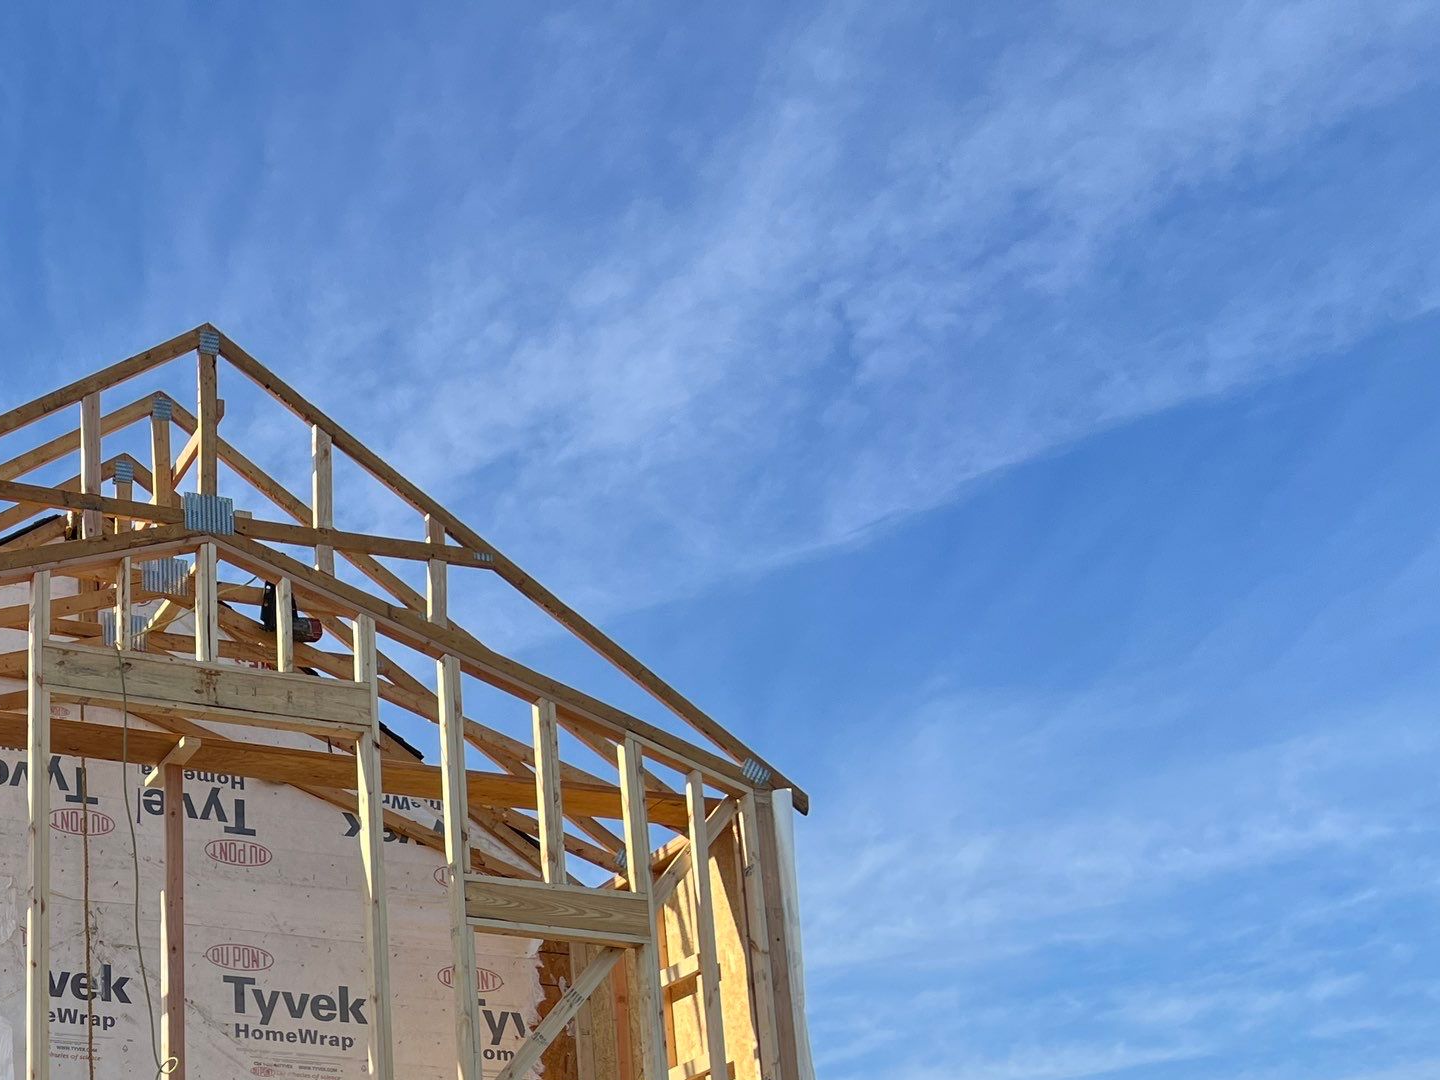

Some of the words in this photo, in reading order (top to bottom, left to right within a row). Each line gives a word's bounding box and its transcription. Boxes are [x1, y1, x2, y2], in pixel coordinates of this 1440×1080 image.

[137, 787, 256, 836] Tyve
[223, 975, 368, 1025] Tyvek
[235, 1022, 354, 1051] HomeWrap
